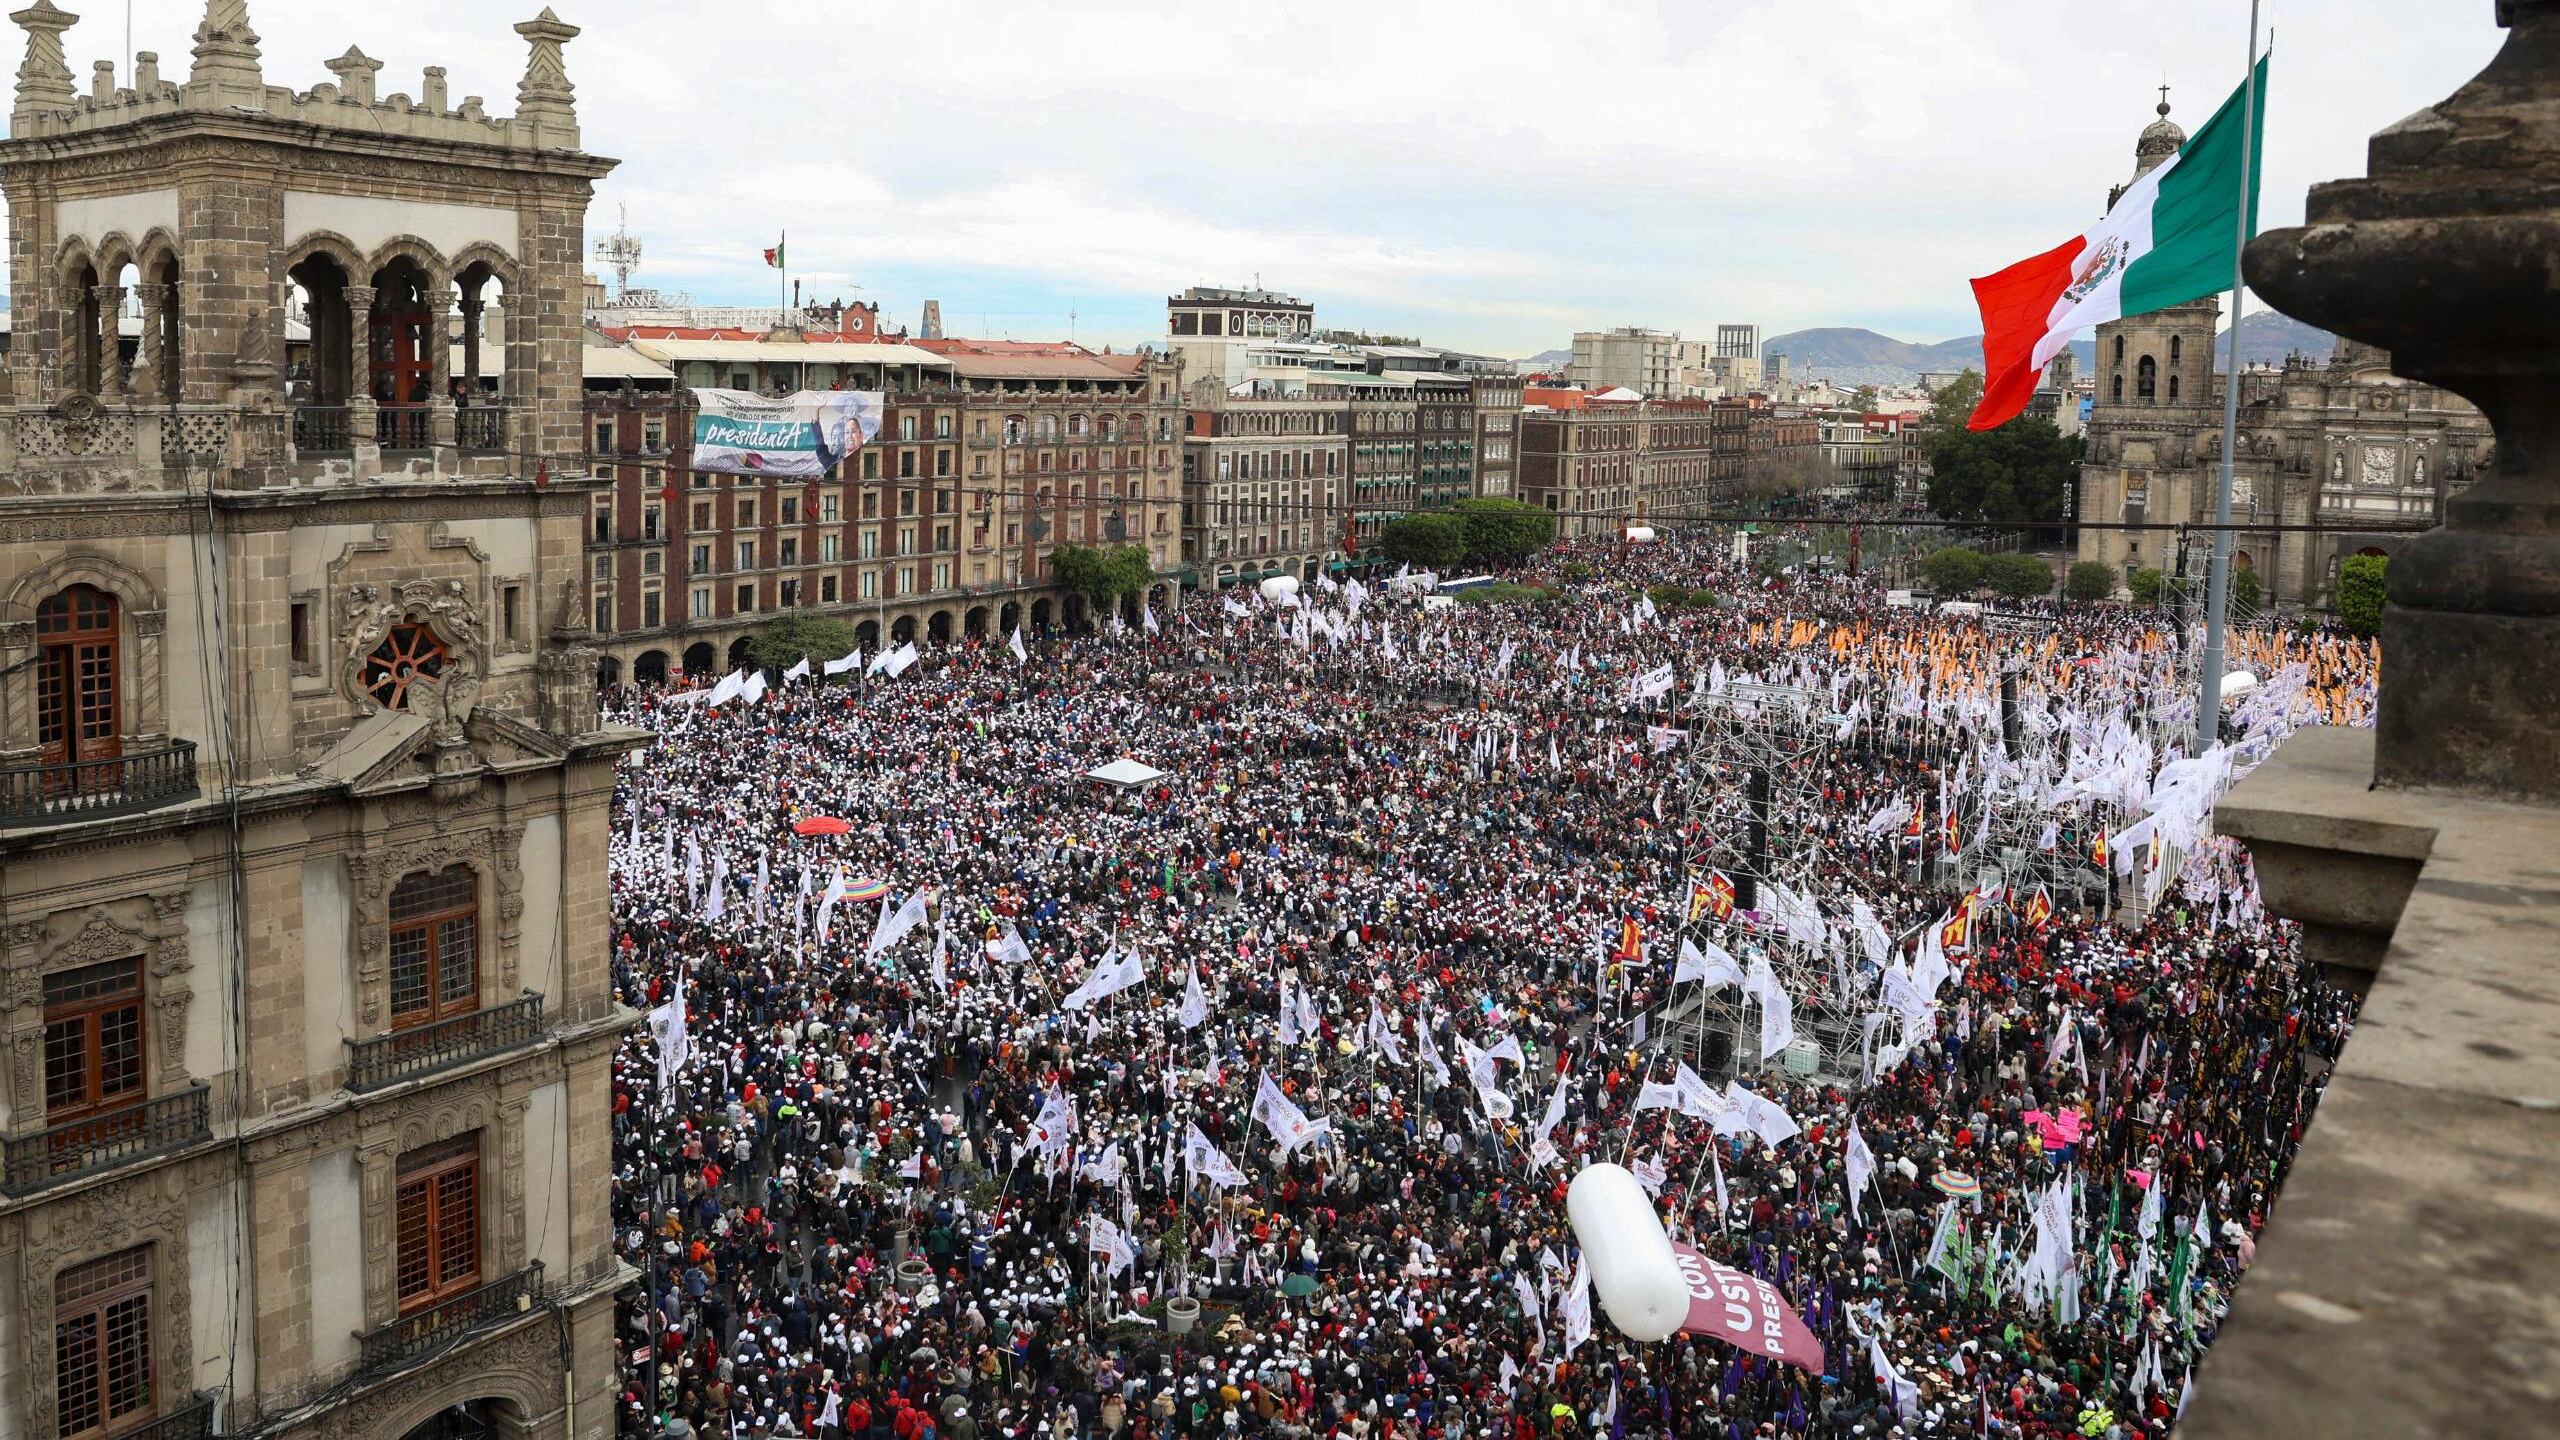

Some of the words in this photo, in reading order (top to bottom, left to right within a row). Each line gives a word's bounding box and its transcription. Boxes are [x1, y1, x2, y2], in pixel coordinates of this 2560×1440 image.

[753, 413, 760, 421] DE
[2037, 711, 2056, 731] GAM
[1675, 1253, 1715, 1300] CON
